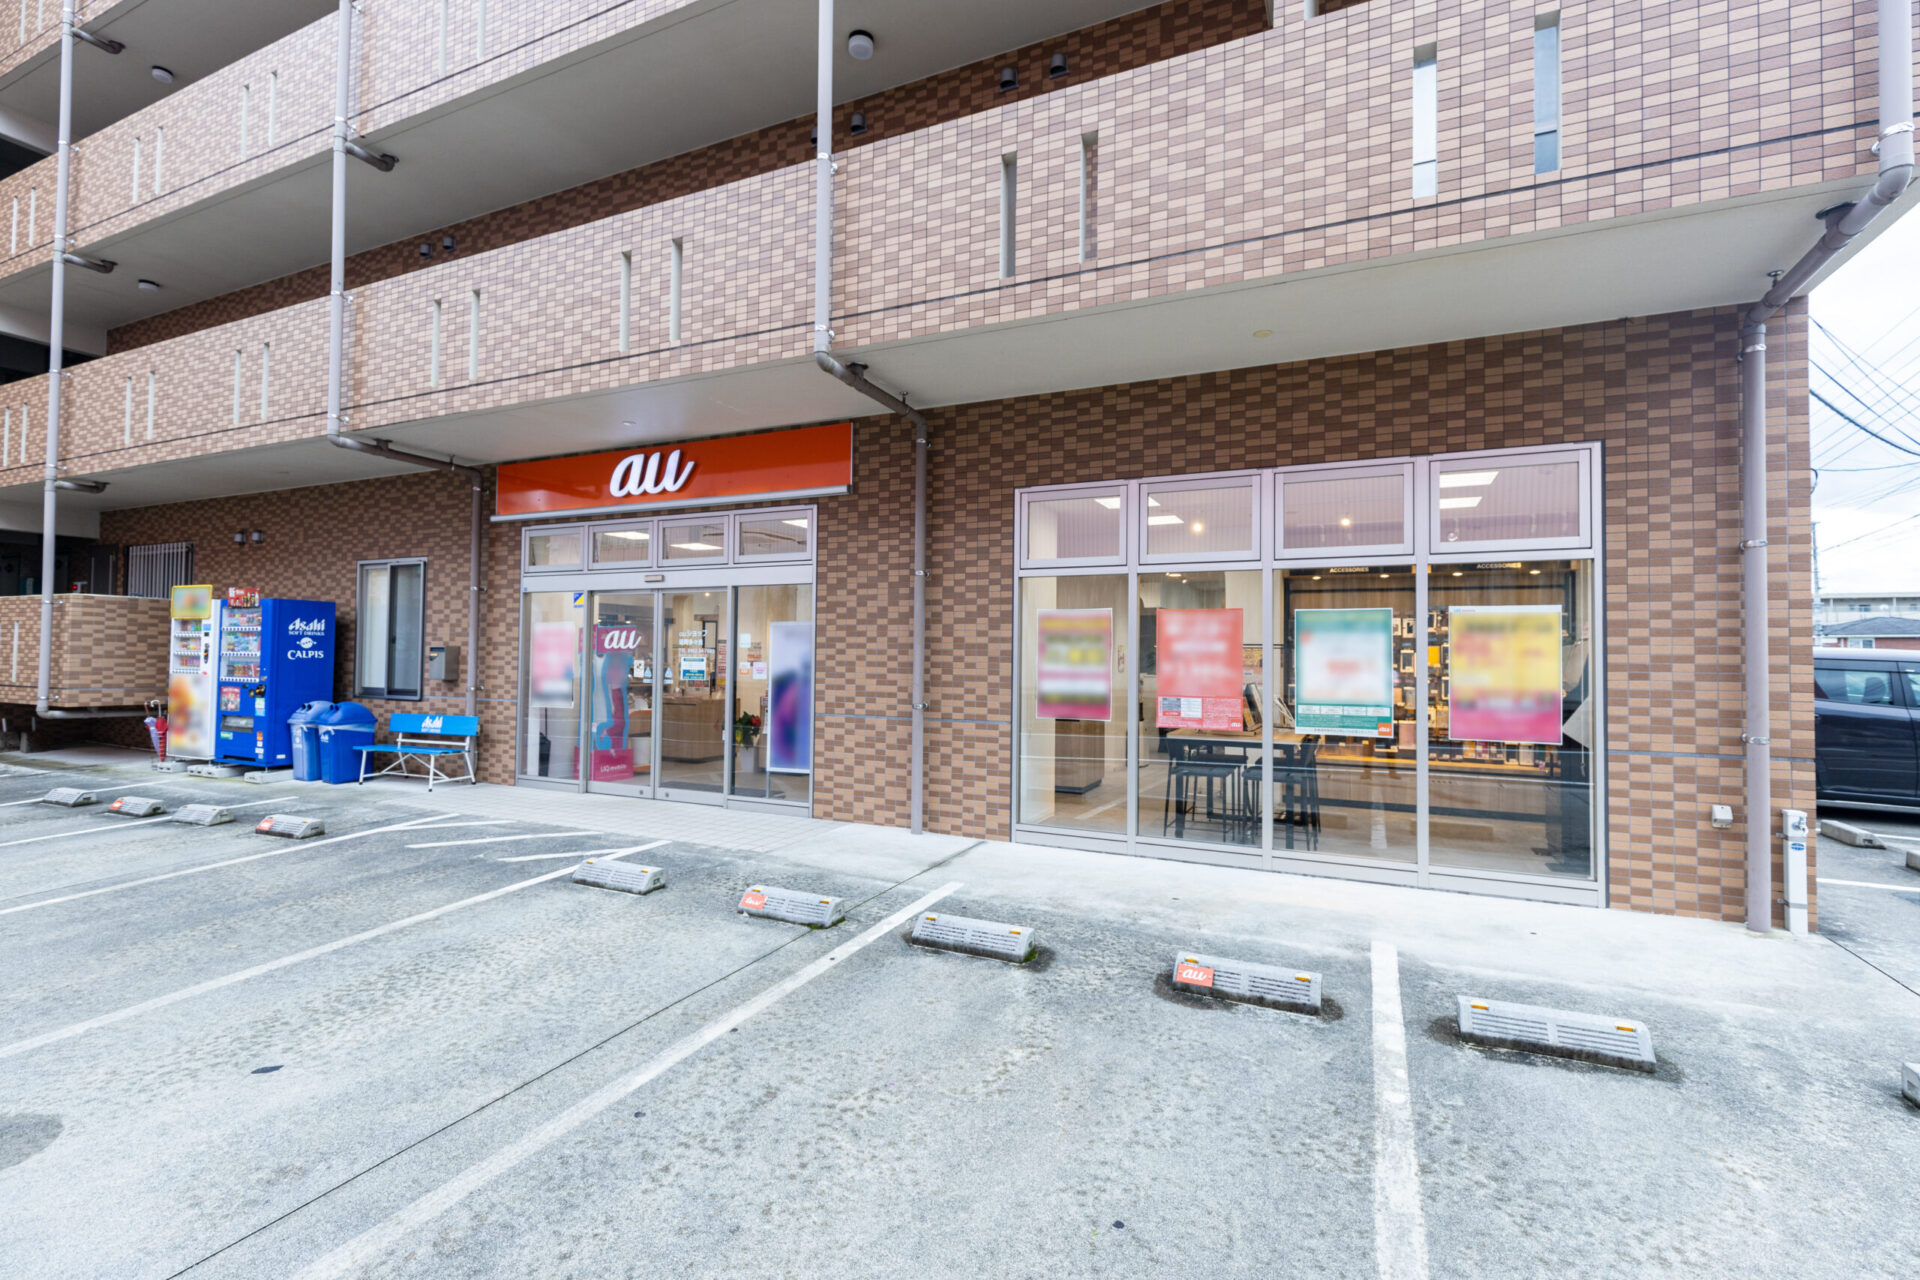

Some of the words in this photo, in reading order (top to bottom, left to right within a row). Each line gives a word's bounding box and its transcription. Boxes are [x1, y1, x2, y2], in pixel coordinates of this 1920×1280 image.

[609, 449, 695, 498] au
[288, 618, 325, 631] Asahi
[604, 629, 642, 649] au
[287, 650, 324, 660] CALPIS
[1182, 968, 1207, 981] au
